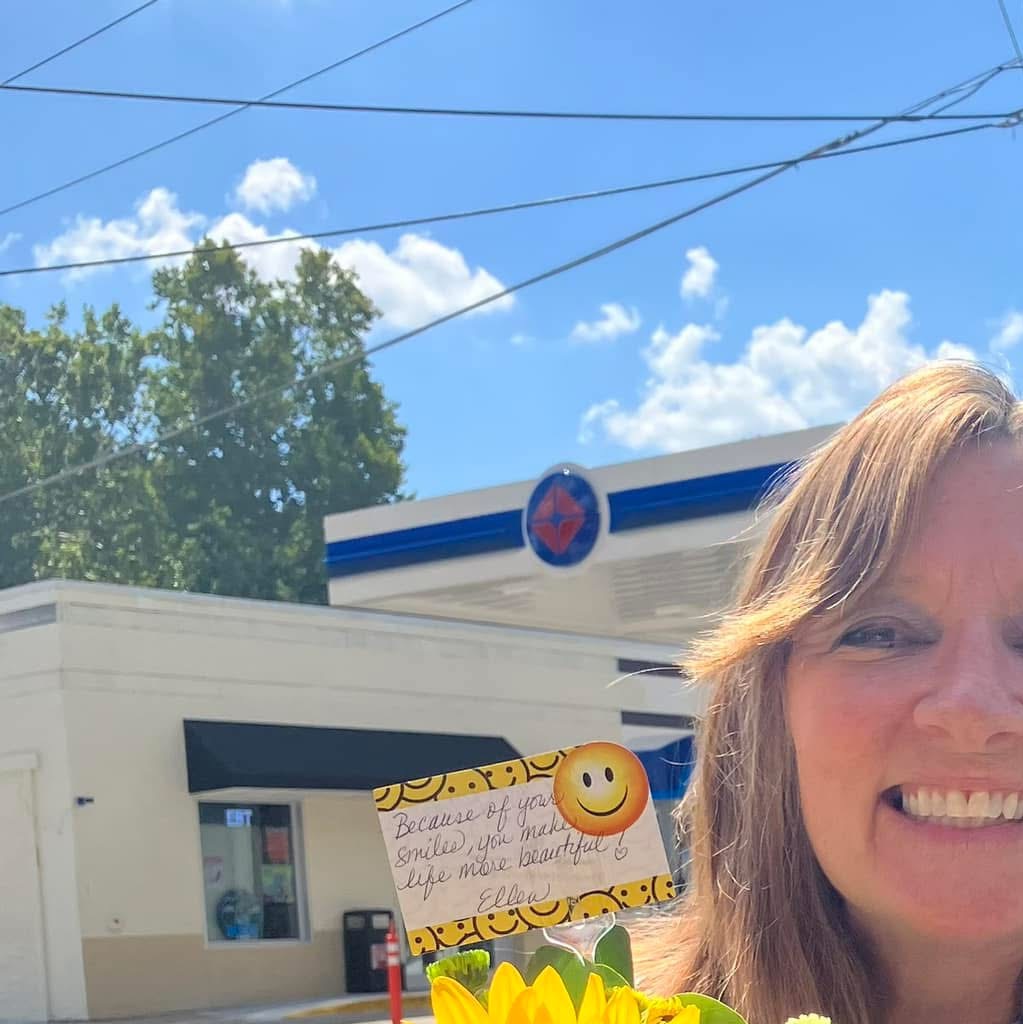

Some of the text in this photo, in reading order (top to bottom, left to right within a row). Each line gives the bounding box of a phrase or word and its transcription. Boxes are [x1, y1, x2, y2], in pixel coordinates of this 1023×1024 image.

[393, 791, 566, 840] Because of your
[477, 832, 513, 864] you
[519, 813, 578, 843] make
[397, 863, 452, 902] life
[458, 857, 513, 880] more
[477, 882, 551, 914] Ellen
